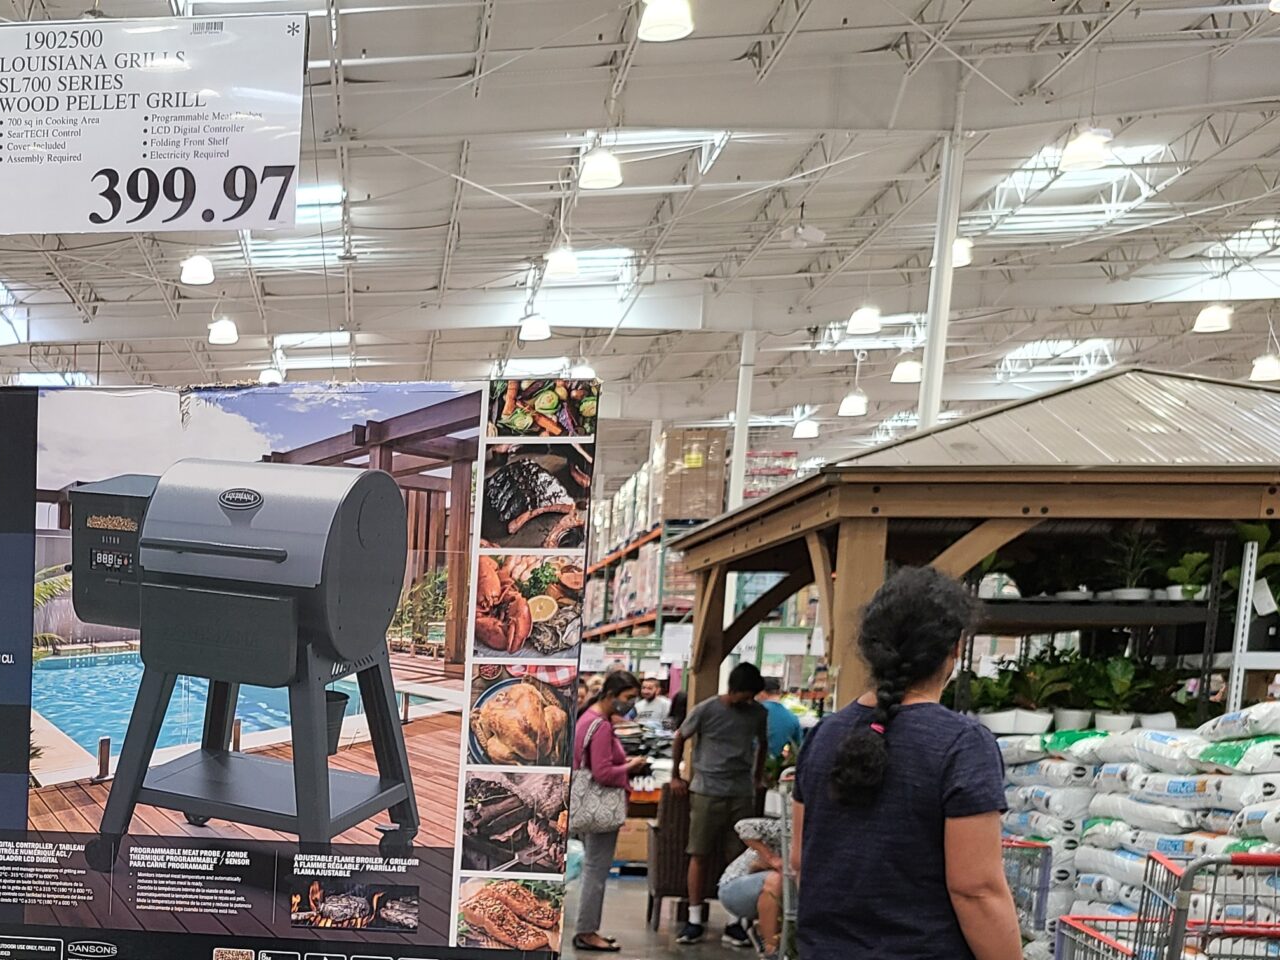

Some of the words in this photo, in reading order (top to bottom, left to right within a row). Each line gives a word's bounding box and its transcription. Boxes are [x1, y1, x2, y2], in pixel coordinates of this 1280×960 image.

[25, 30, 103, 50] 1902500
[0, 54, 107, 73] LOUISIANA
[0, 77, 51, 93] SL700
[58, 74, 123, 91] SERIES
[0, 96, 59, 113] WOOD
[66, 94, 140, 111] PELLET
[146, 91, 206, 108] GRILL
[8, 118, 22, 126] 700
[24, 119, 32, 127] sq
[36, 117, 42, 125] in
[46, 117, 78, 126] Cooking
[151, 113, 208, 123] Programmable
[7, 130, 48, 138] SearTECH
[52, 129, 81, 137] Control
[151, 126, 170, 134] LCD
[174, 125, 200, 135] Digital
[204, 124, 244, 133] Controller
[7, 142, 30, 151] Cover
[33, 141, 66, 150] Included
[151, 139, 180, 148] Folding
[184, 138, 204, 146] Front
[208, 137, 229, 145] Shelf
[7, 155, 44, 164] Assembly
[48, 154, 82, 163] Required
[150, 151, 190, 161] Electricity
[194, 150, 229, 160] Required
[89, 165, 295, 224] 399.97
[130, 847, 181, 855] PROGRAMMABLE
[129, 854, 164, 862] THERMIQUE
[166, 856, 217, 864] PROGRAMMABLE
[294, 854, 332, 862] ADJUSTABLE
[334, 855, 355, 863] FLAME
[356, 856, 383, 864] BROILER
[390, 858, 419, 866] GRILLOIR
[168, 862, 214, 870] PROGRAMABLE
[316, 869, 351, 877] AJUSTABLE
[68, 944, 117, 954] DANSONS
